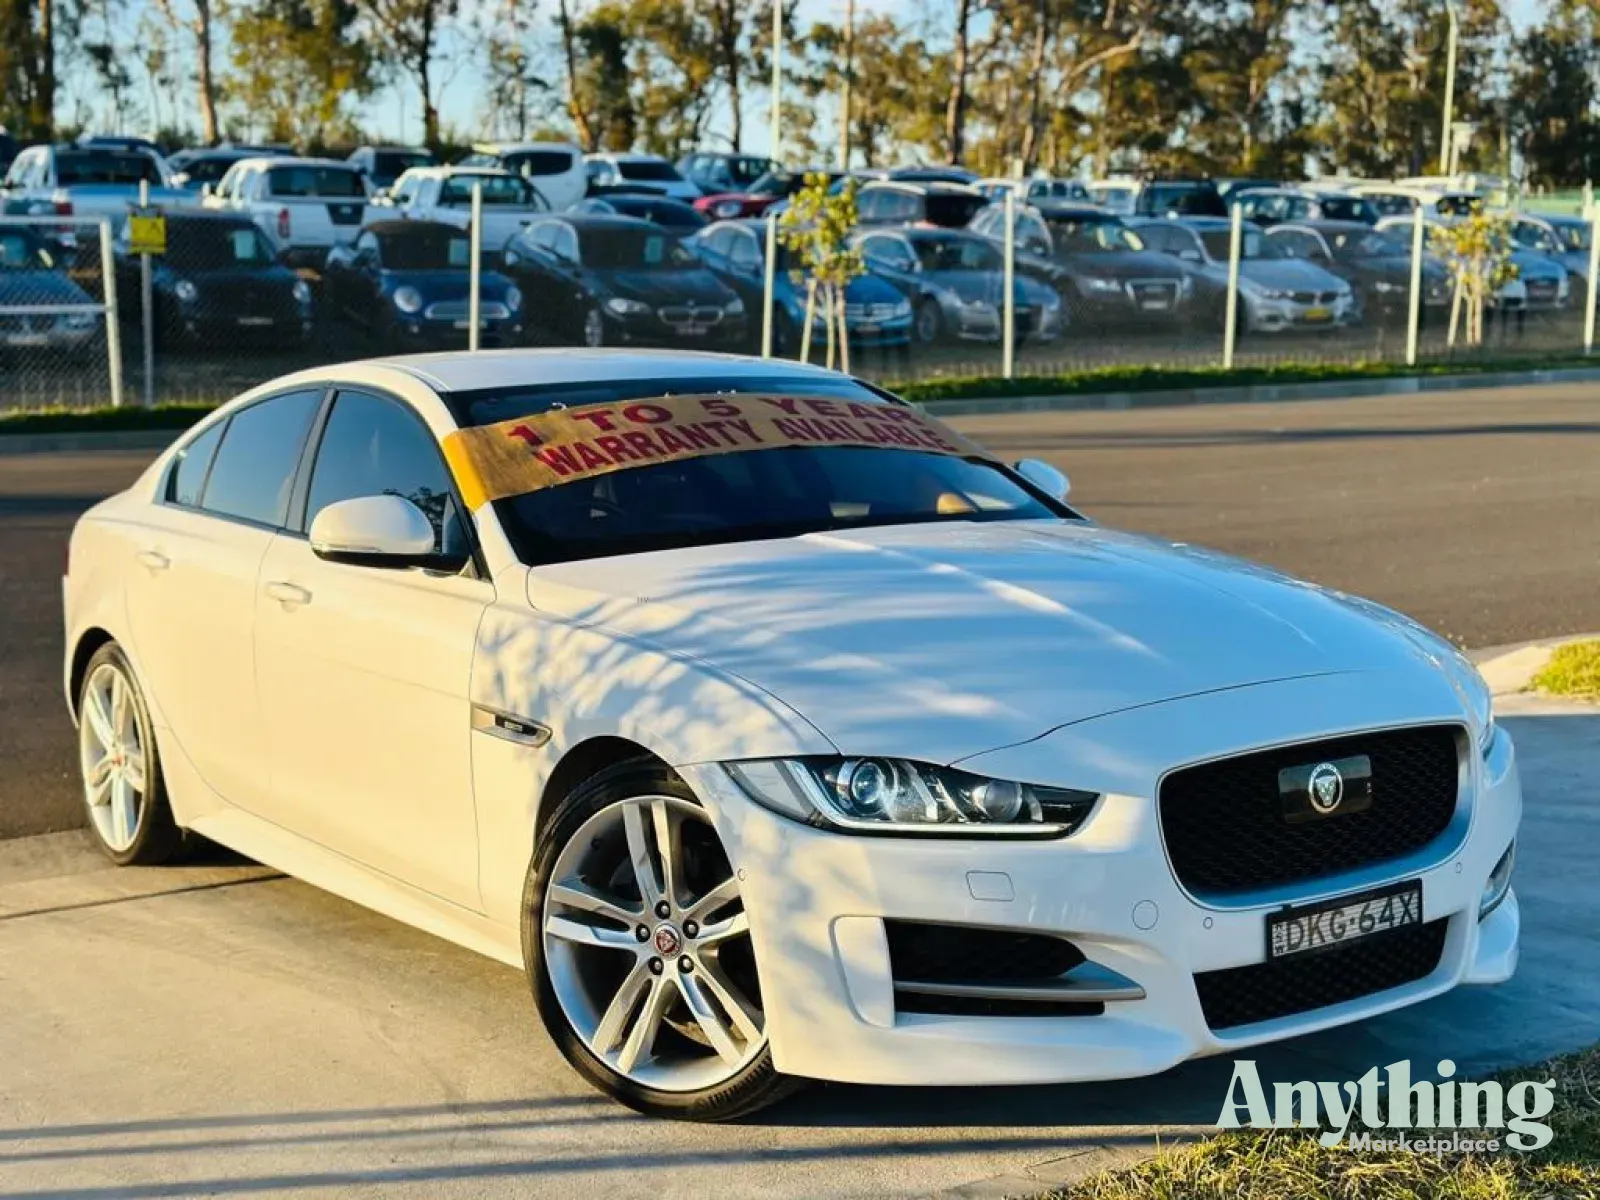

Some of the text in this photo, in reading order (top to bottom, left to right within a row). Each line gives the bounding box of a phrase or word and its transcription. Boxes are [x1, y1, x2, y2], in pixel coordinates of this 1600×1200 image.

[508, 398, 925, 447] 1 TO 5 YEAR
[532, 418, 959, 476] WARRANTY AVAILABLE
